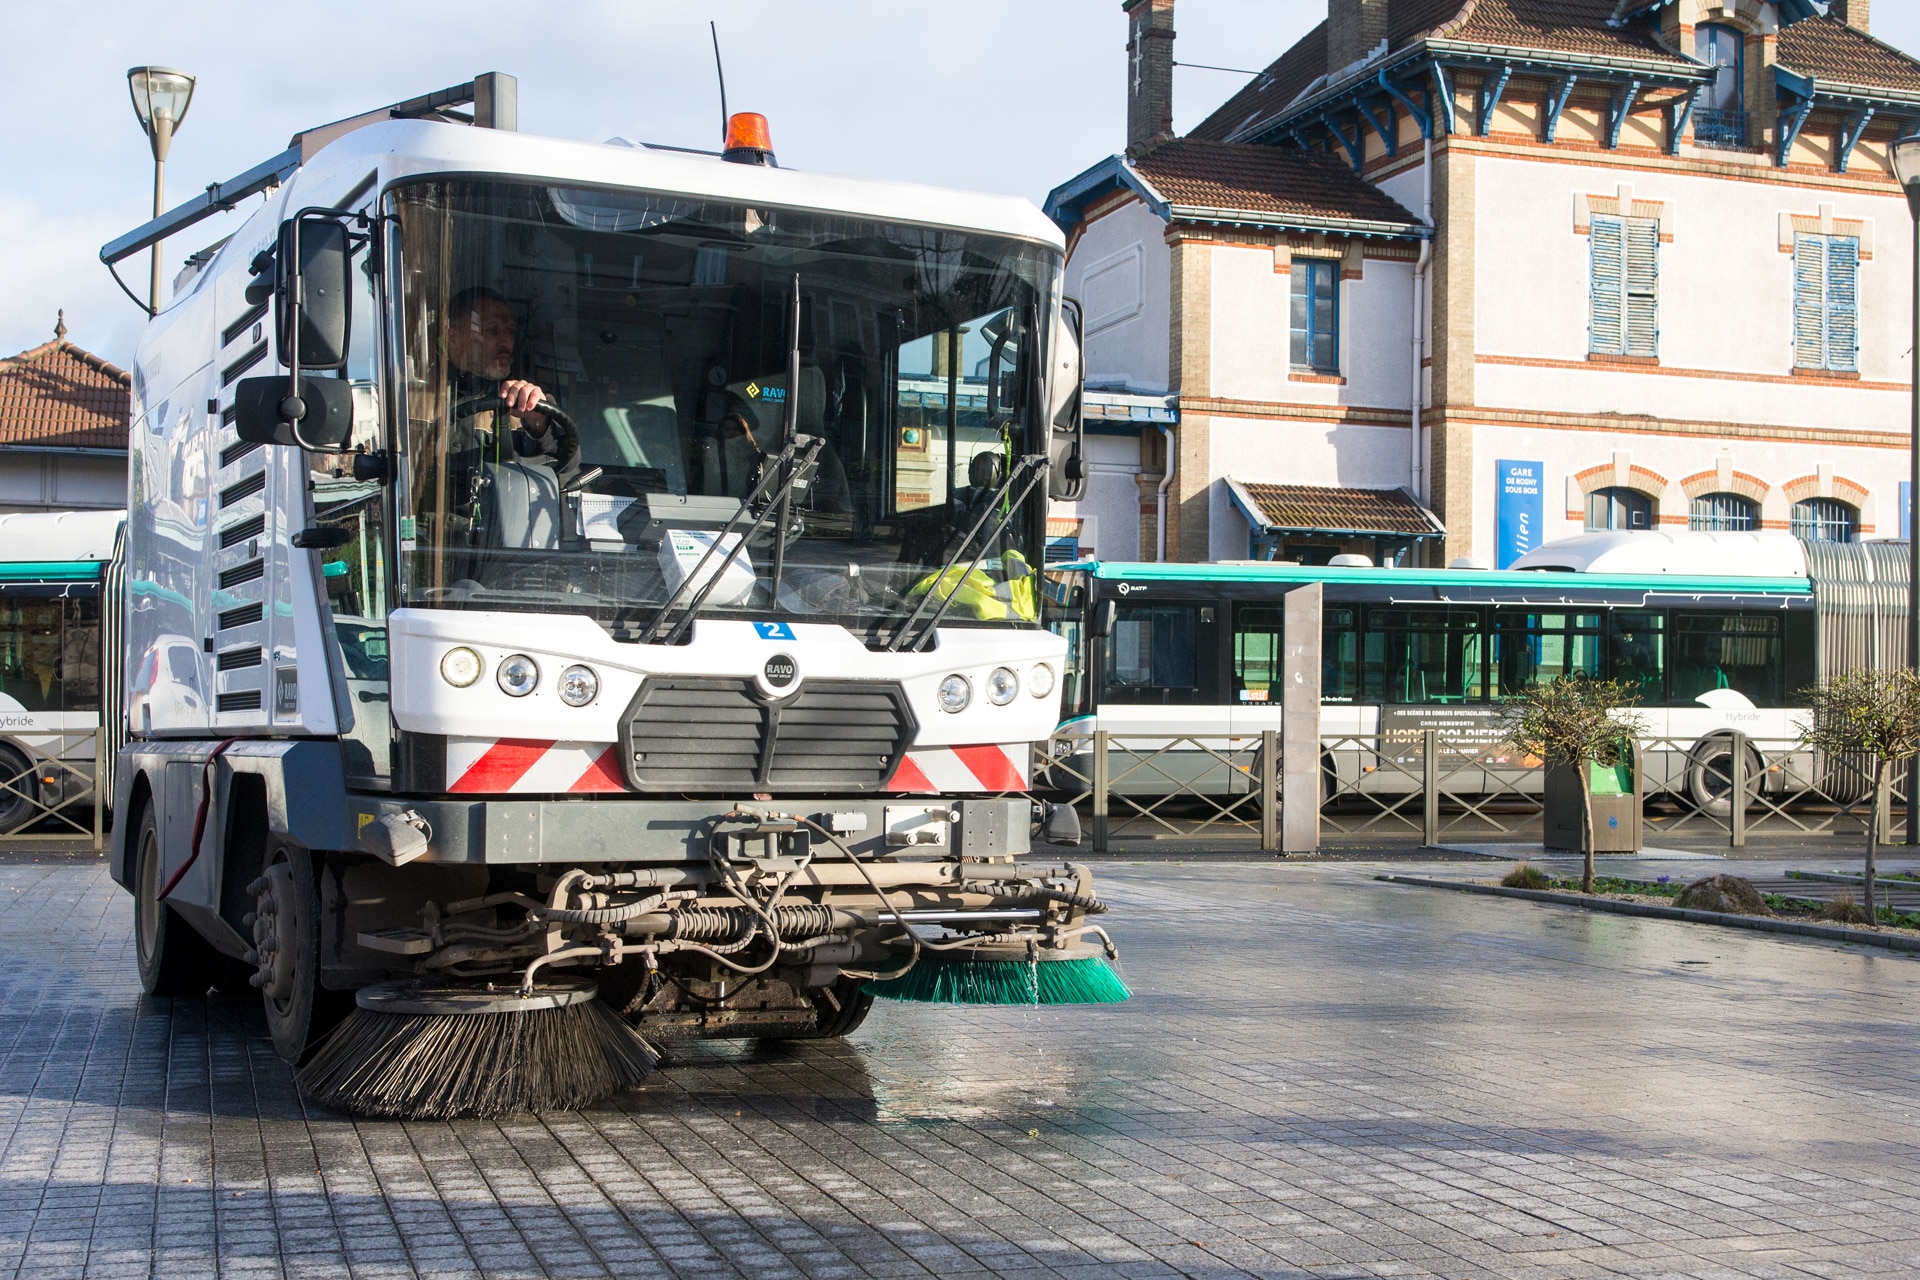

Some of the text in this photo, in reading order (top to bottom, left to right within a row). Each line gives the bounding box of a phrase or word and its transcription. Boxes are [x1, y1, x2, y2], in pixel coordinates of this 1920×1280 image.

[1510, 468, 1533, 477] GARE
[1506, 477, 1537, 486] DE ROSNY
[1505, 486, 1538, 495] SOUS BOIS
[763, 622, 785, 637] 2
[766, 664, 793, 675] RAVO
[0, 716, 34, 728] ybride
[1726, 712, 1760, 723] Hybride
[1385, 728, 1436, 743] HORS
